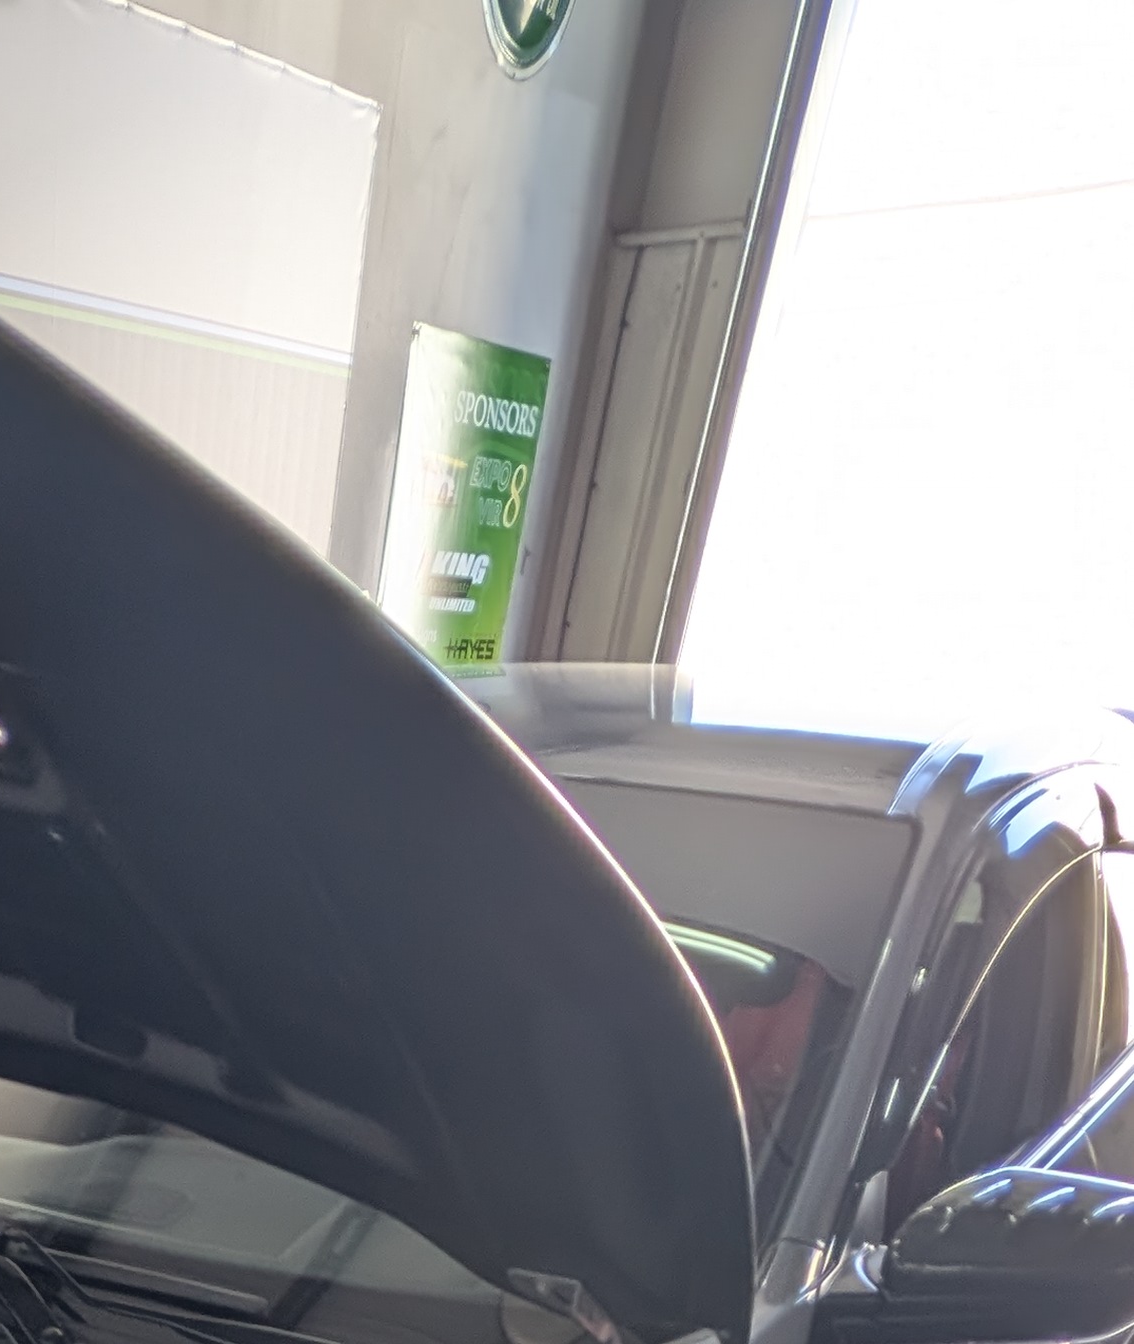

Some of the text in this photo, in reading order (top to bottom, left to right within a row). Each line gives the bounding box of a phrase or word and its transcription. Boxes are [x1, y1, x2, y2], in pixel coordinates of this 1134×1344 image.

[454, 390, 540, 438] SPONSORS
[431, 550, 490, 585] KING
[443, 637, 496, 661] HAYES
